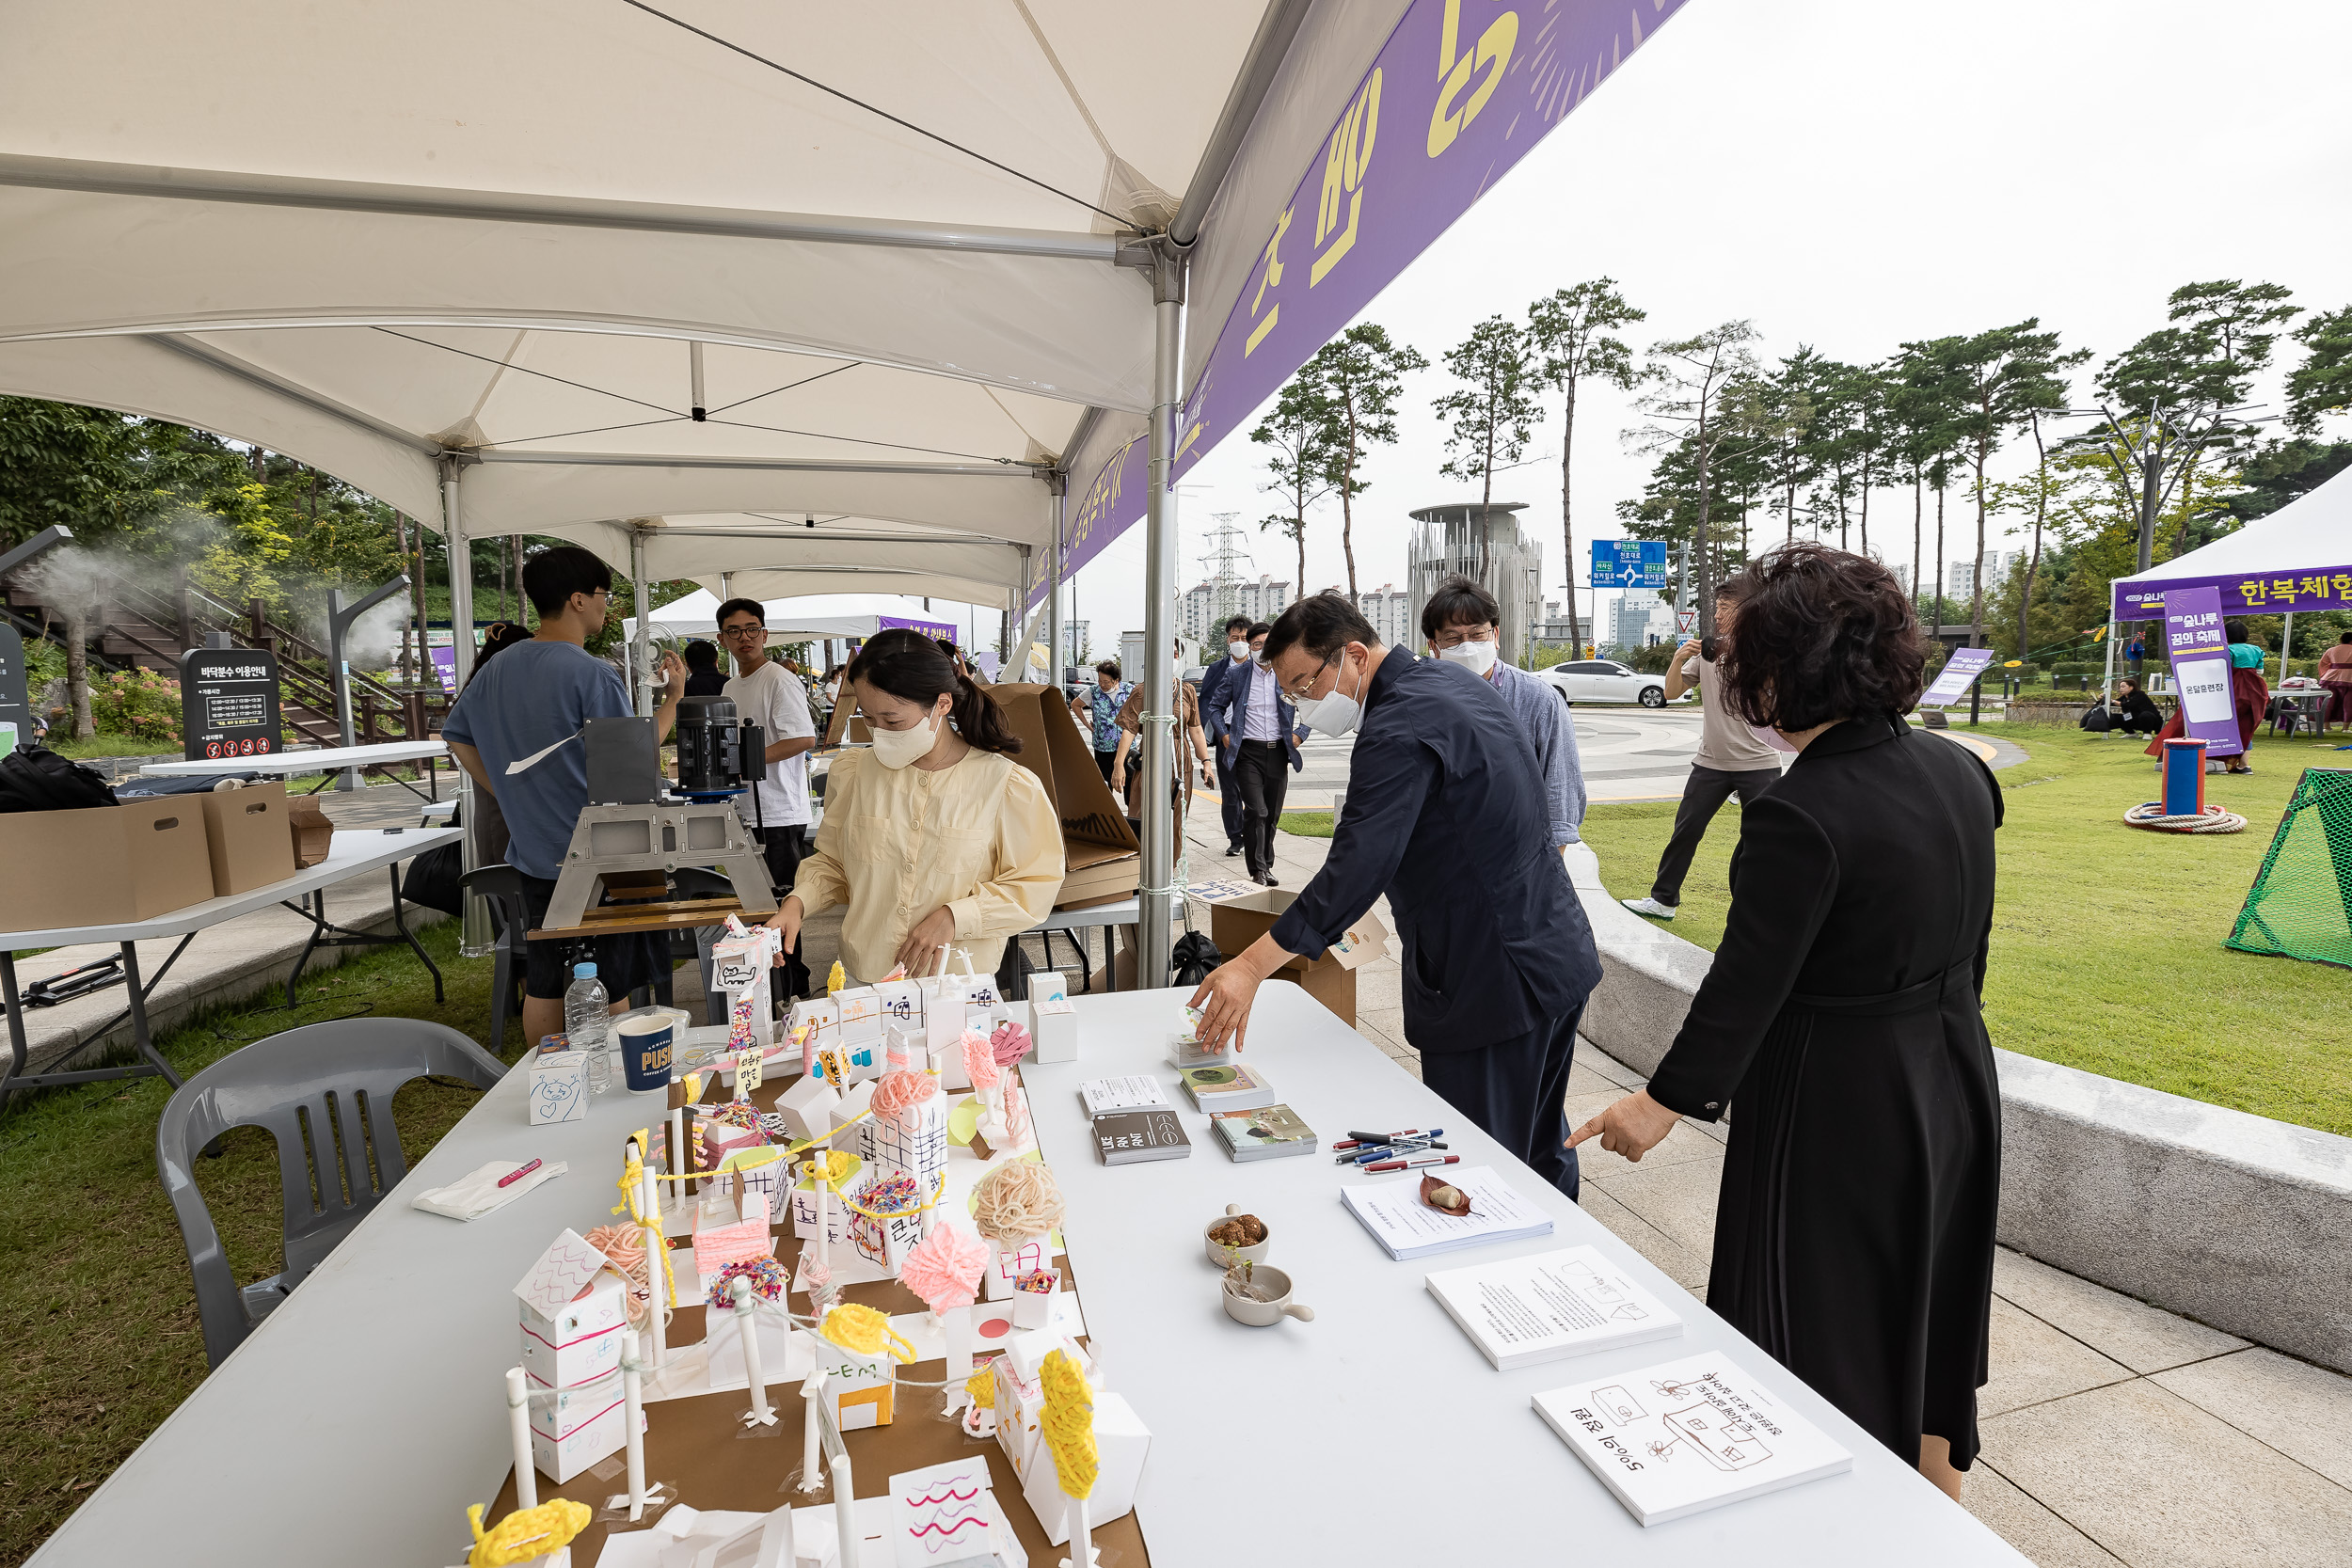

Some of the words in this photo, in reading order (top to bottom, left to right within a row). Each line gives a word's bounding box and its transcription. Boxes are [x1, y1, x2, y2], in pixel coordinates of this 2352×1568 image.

[2184, 612, 2218, 628] 숲나루
[2171, 632, 2194, 646] 꿈의
[2196, 629, 2221, 643] 축제
[200, 666, 234, 677] 바닥분수
[235, 665, 266, 677] 이용안내
[2185, 683, 2224, 694] 온달훈련장
[642, 1043, 673, 1071] PUSH
[1102, 1135, 1114, 1150] LIKE
[1116, 1136, 1129, 1148] AN
[1130, 1132, 1144, 1148] ANT
[891, 1219, 907, 1243] 큰
[1703, 1373, 1732, 1394] 싶어요
[1696, 1385, 1726, 1409] 살아도
[1730, 1396, 1752, 1411] 갖고
[1571, 1408, 1603, 1433] 정원
[1723, 1408, 1756, 1433] 도시에
[1750, 1413, 1782, 1435] 정원은
[1598, 1436, 1644, 1470] 5%의
